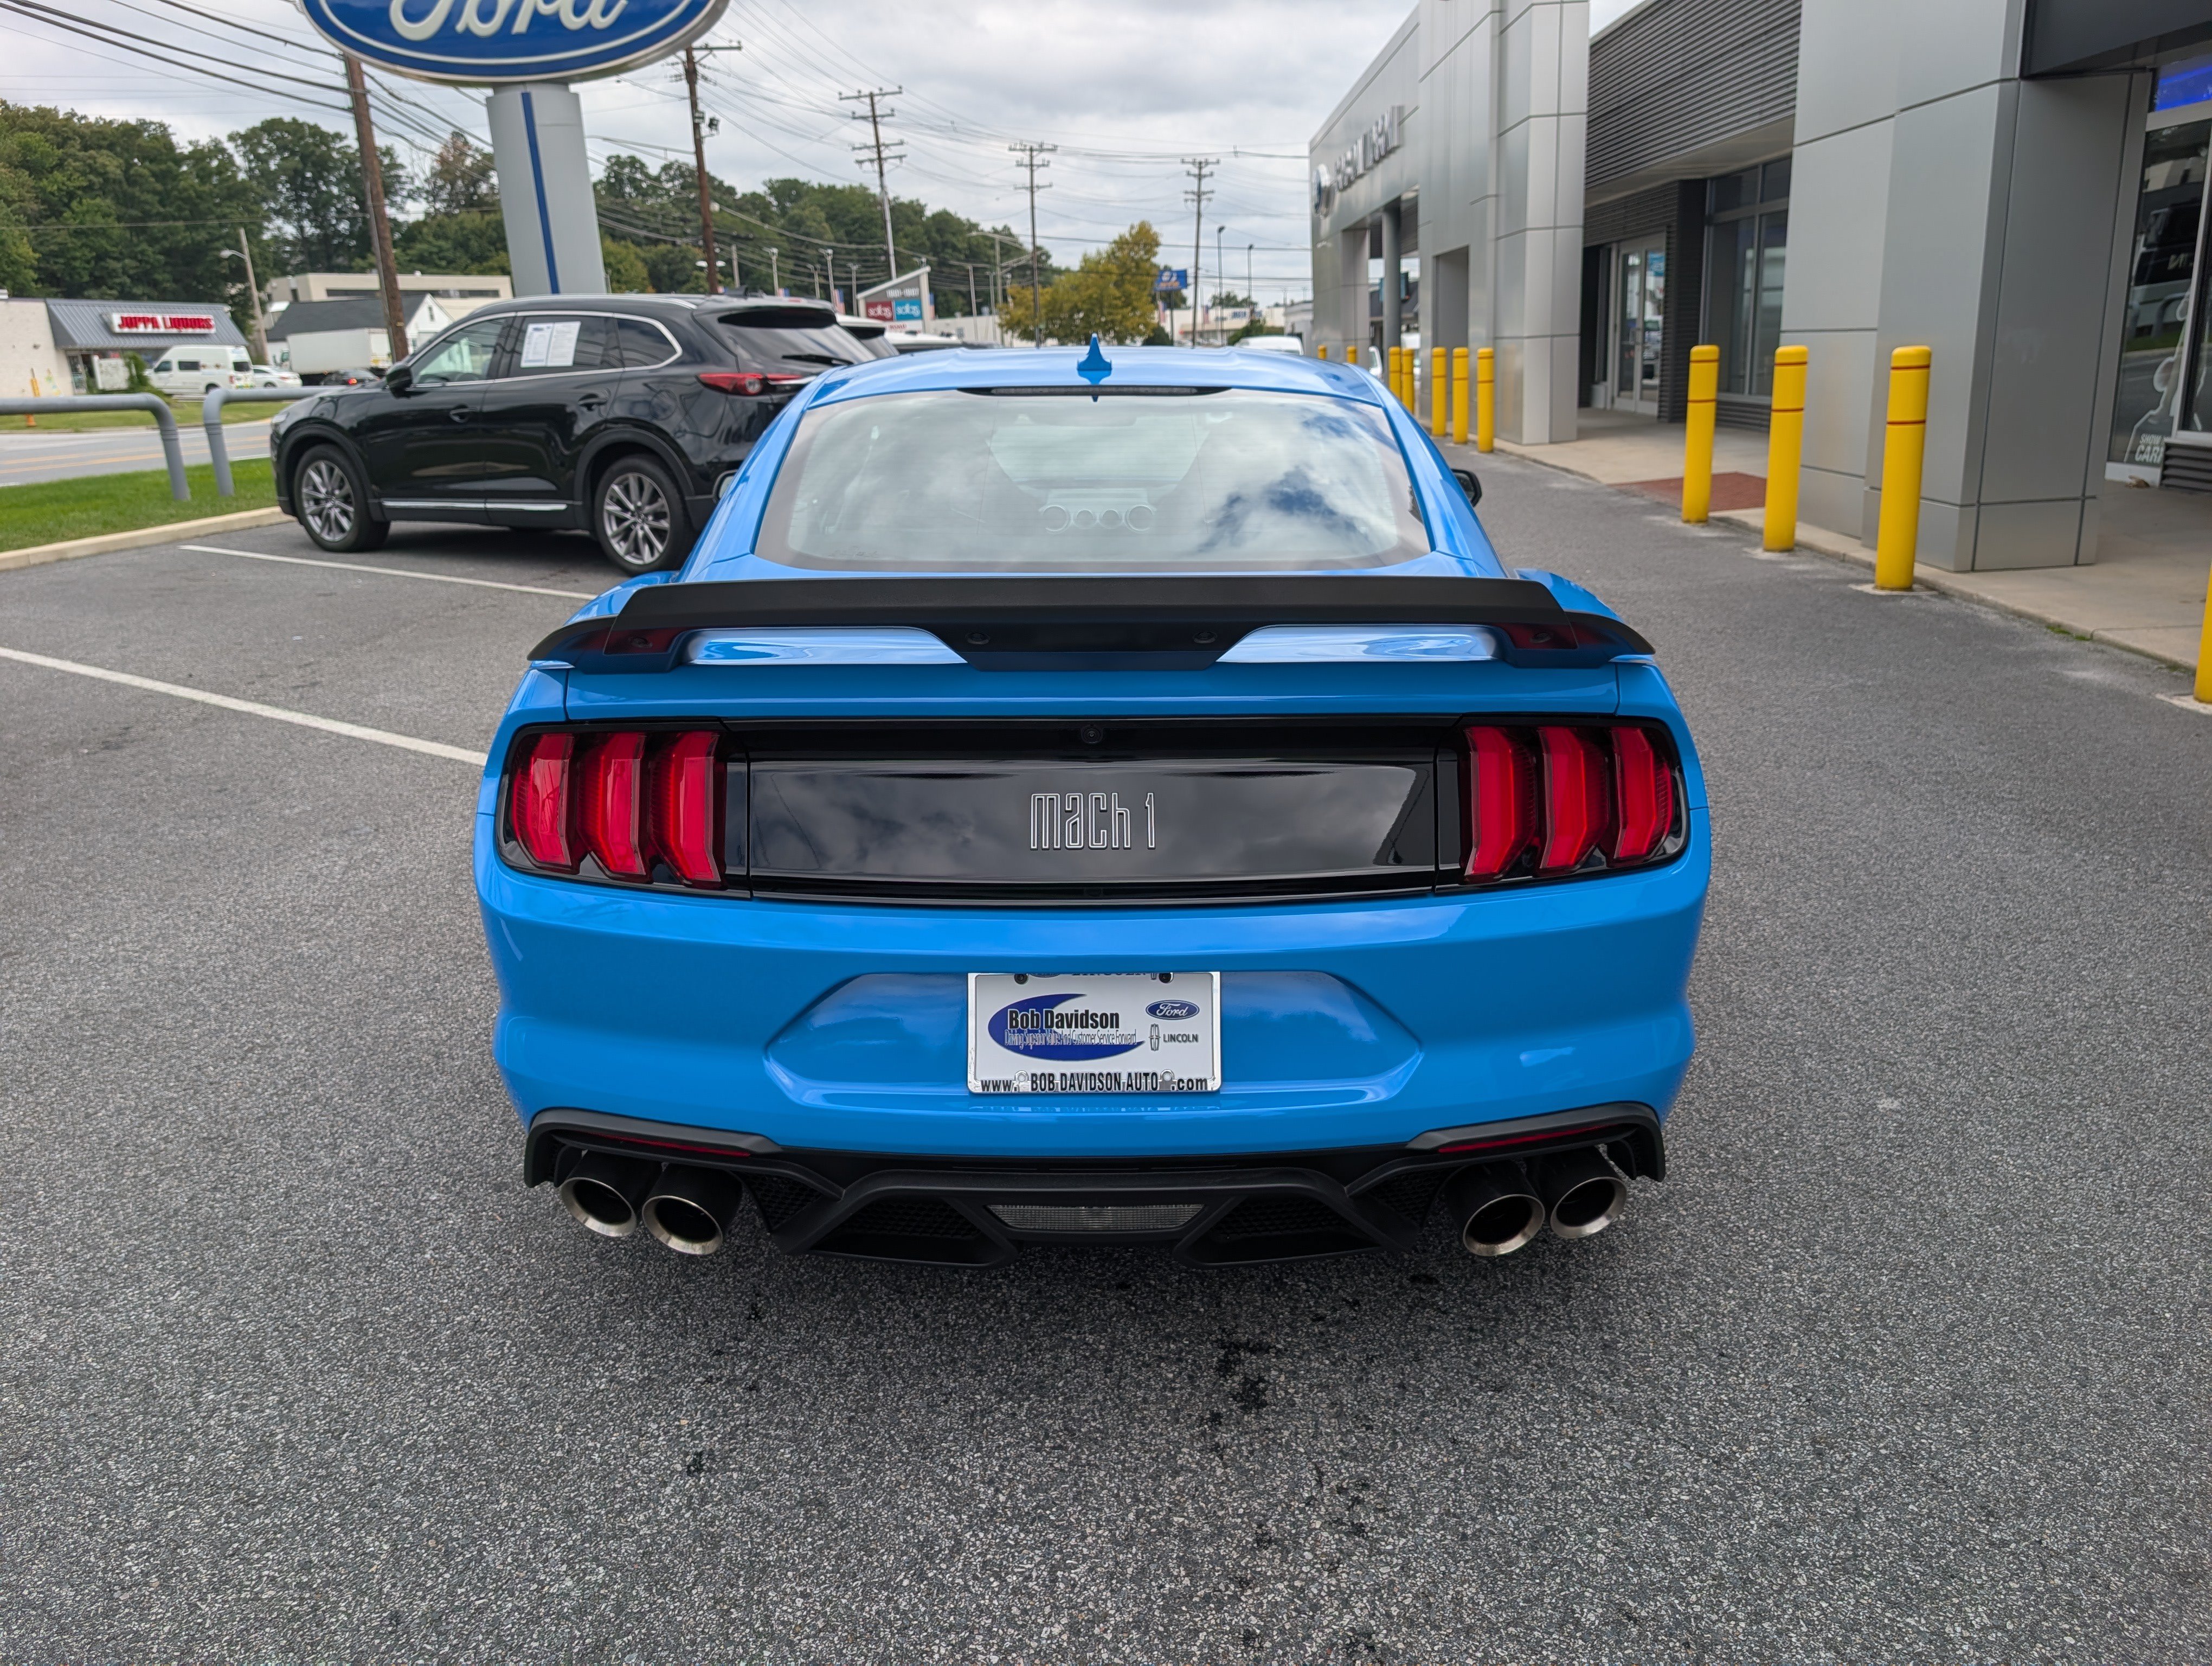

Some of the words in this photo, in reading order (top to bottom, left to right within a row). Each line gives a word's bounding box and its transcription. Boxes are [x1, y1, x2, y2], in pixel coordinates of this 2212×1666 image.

[1144, 792, 1156, 850] 1
[1008, 1009, 1040, 1030] Bob
[1044, 1009, 1120, 1029] Davidson
[1156, 1001, 1189, 1017] Ford
[1005, 1029, 1024, 1050] Driving
[1024, 1029, 1045, 1050] Superior
[1072, 1029, 1096, 1045] Customer
[1097, 1029, 1115, 1045] Service
[1115, 1028, 1137, 1045] Forward
[1163, 1033, 1199, 1043] LINCOLN
